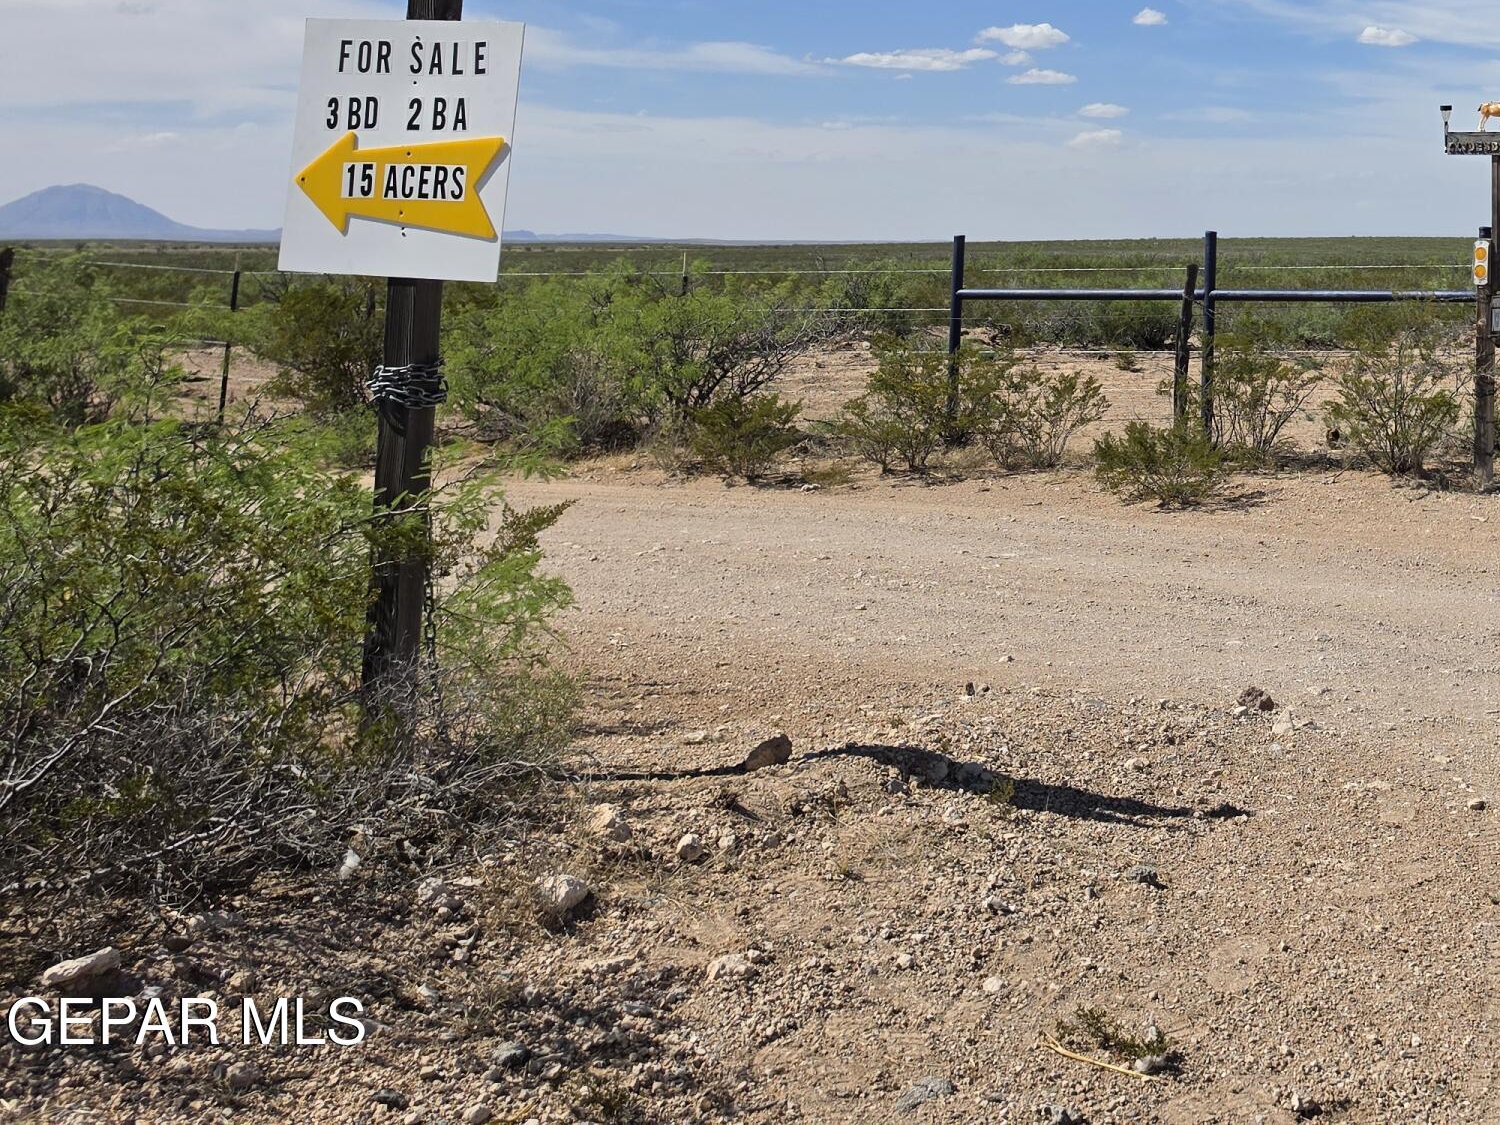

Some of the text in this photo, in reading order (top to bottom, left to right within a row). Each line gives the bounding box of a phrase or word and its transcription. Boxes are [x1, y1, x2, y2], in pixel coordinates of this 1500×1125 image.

[337, 39, 487, 75] FOR SALE
[346, 163, 465, 200] 15 ACERS
